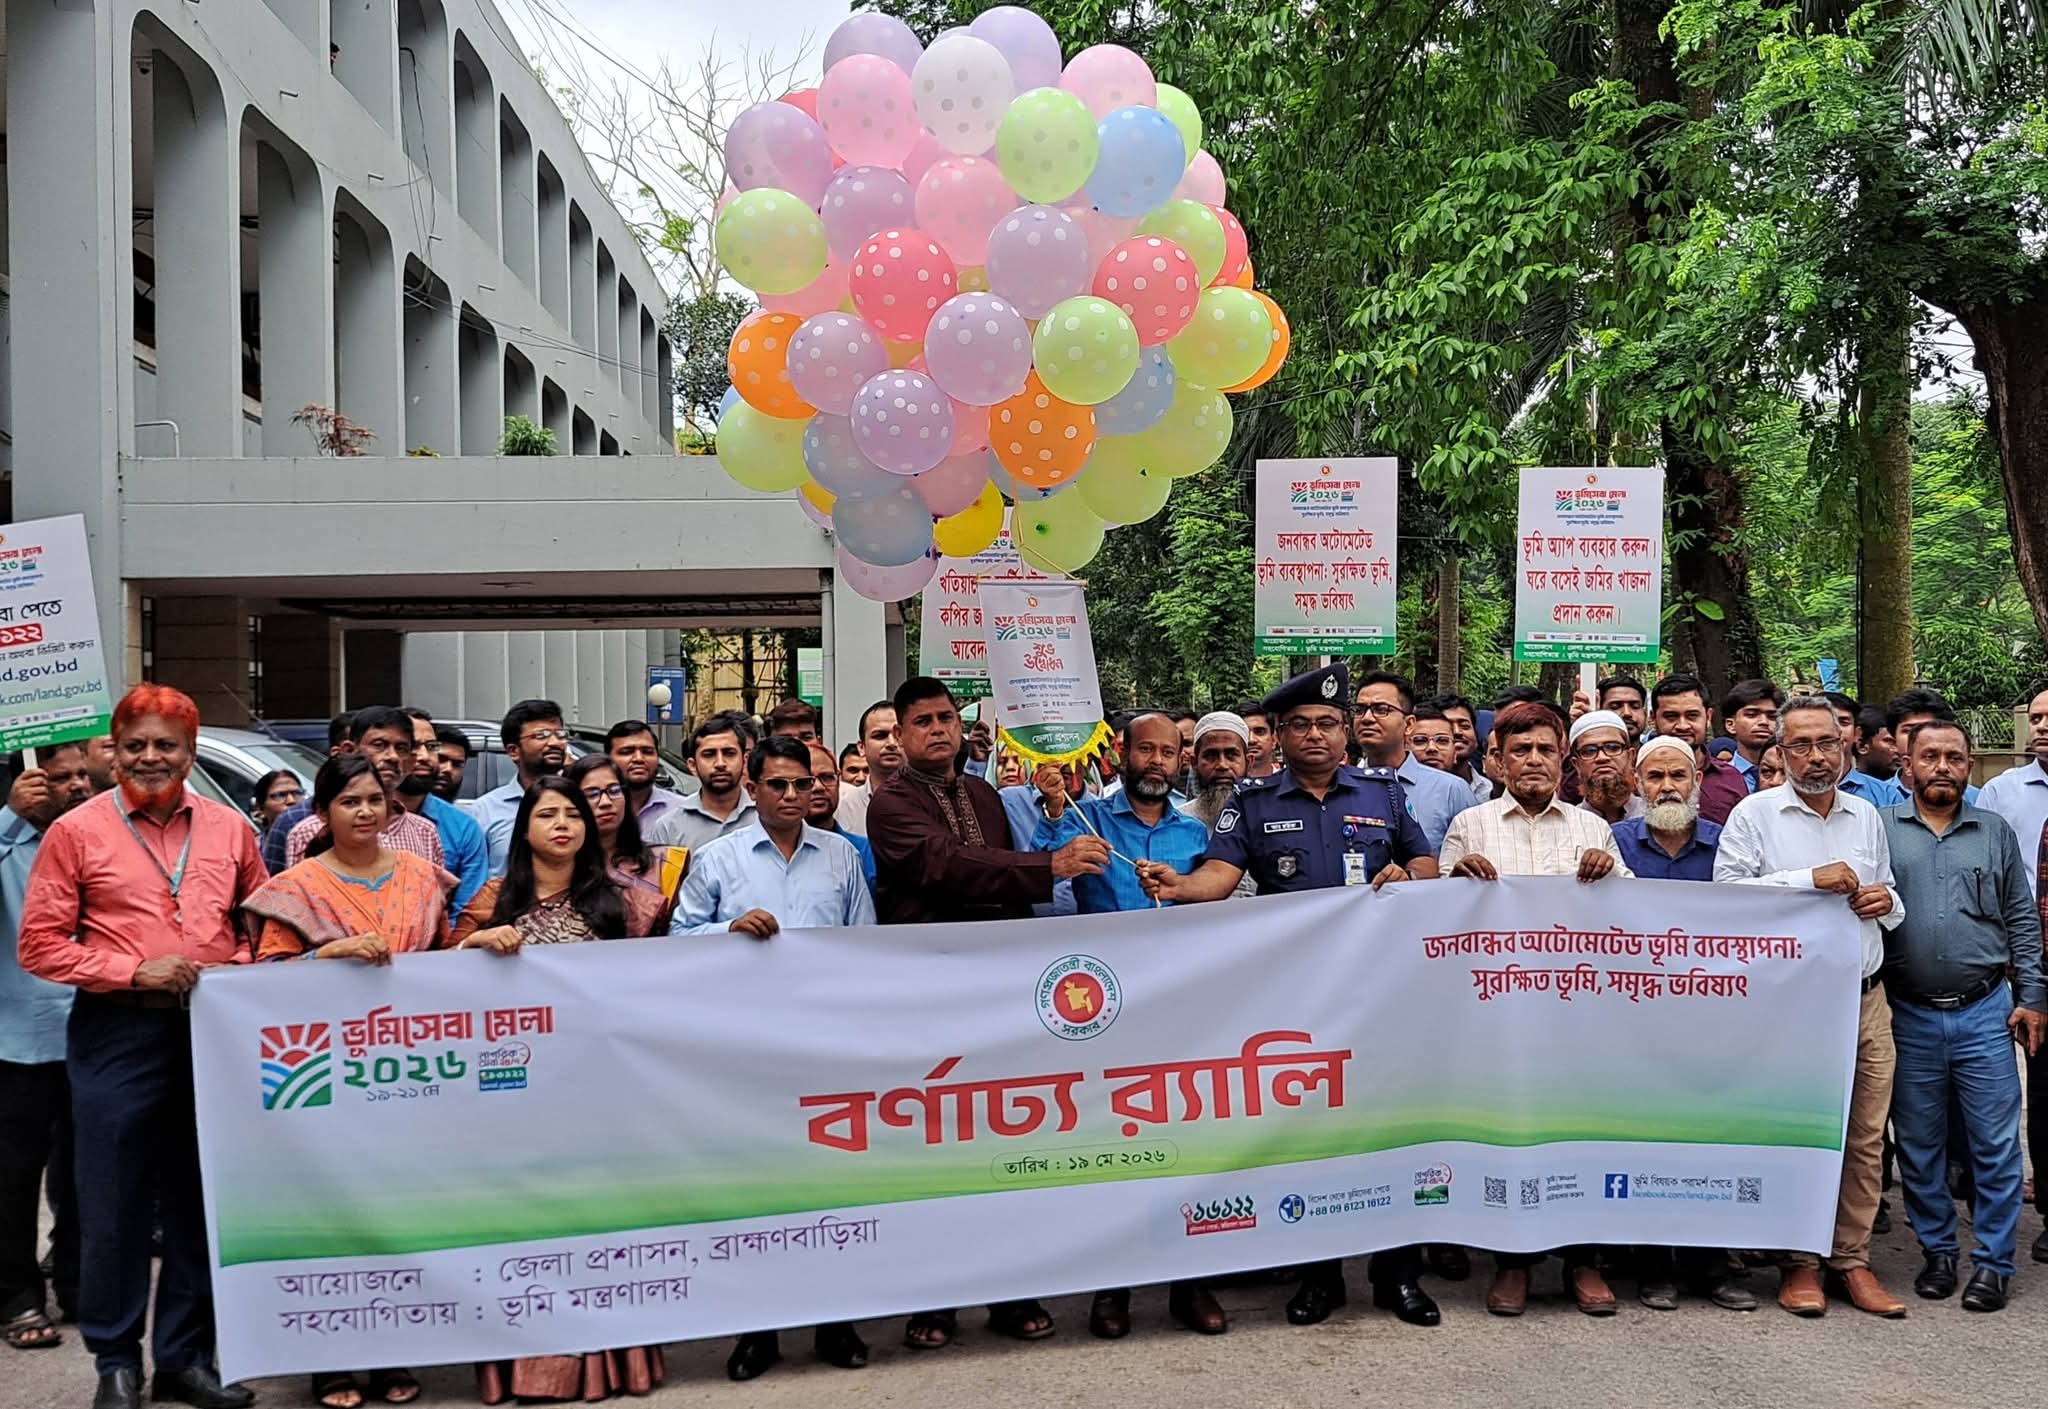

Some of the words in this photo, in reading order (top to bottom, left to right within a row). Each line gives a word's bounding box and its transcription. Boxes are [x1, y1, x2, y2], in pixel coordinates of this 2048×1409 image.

[1277, 532, 1317, 551] জনবান্ধব
[1320, 527, 1373, 551] অটোমেটেড
[1522, 530, 1544, 563] ভূমি
[1548, 537, 1576, 558] অ্যাপ
[1579, 536, 1617, 560] ব্যবহার
[1256, 557, 1275, 587] ভূমি
[1279, 562, 1327, 584] ব্যবস্থাপনা:
[1331, 557, 1366, 585] সুরক্ষিত
[1370, 557, 1393, 587] ভূমি,
[1526, 571, 1548, 591] ঘরে
[1551, 566, 1580, 592] বসেই
[1585, 564, 1614, 590] জমির
[1617, 571, 1652, 592] খাজনা
[21, 600, 63, 619] পেতে
[939, 601, 969, 627] কপির
[1294, 592, 1317, 617] সমৃদ্ধ
[1321, 587, 1355, 611] ভবিষ্যৎ
[1552, 604, 1581, 625] প্রদান
[1422, 930, 1516, 960] জনবান্ধব
[1519, 924, 1644, 956] অটোমেটেড
[1647, 928, 1689, 965] ভূমি
[1693, 935, 1803, 964] ব্যবস্থাপনা:
[1084, 960, 1117, 1003] বাংলাদেশ
[1471, 963, 1551, 1001] সুরক্ষিত
[1554, 962, 1602, 1001] ভূমি,
[1606, 969, 1663, 1003] সমৃদ্ধ
[1667, 968, 1748, 998] ভবিষ্যৎ
[342, 1003, 472, 1058] ভূমিসেবা
[484, 1005, 554, 1042] মেলা
[1061, 1021, 1101, 1036] সরকার
[343, 1050, 466, 1088] ২০২৬
[365, 1087, 418, 1103] ১৯-২১
[422, 1084, 440, 1098] মে
[799, 1055, 1084, 1154] বর্ণাঢ্য
[1004, 1153, 1050, 1175] তারিখ
[1067, 1154, 1089, 1170] ১৯
[1095, 1150, 1114, 1168] মে
[1120, 1147, 1166, 1166] ২০২৬
[1711, 1178, 1733, 1188] পেতে
[1192, 1194, 1255, 1221] ১৬১২২
[1308, 1205, 1328, 1217] +88
[1330, 1204, 1342, 1214] 09
[1344, 1200, 1365, 1212] 6123
[1366, 1196, 1391, 1208] 16122
[275, 1267, 423, 1298] আয়োজনে
[499, 1253, 574, 1283] জেলা
[586, 1240, 698, 1272] প্রশাসন,
[709, 1216, 881, 1260] ব্রাহ্মণবাড়িয়া
[278, 1300, 458, 1335] সহযোগিতায়
[498, 1285, 554, 1329] ভূমি
[571, 1275, 691, 1308] মন্ত্রণালয়
